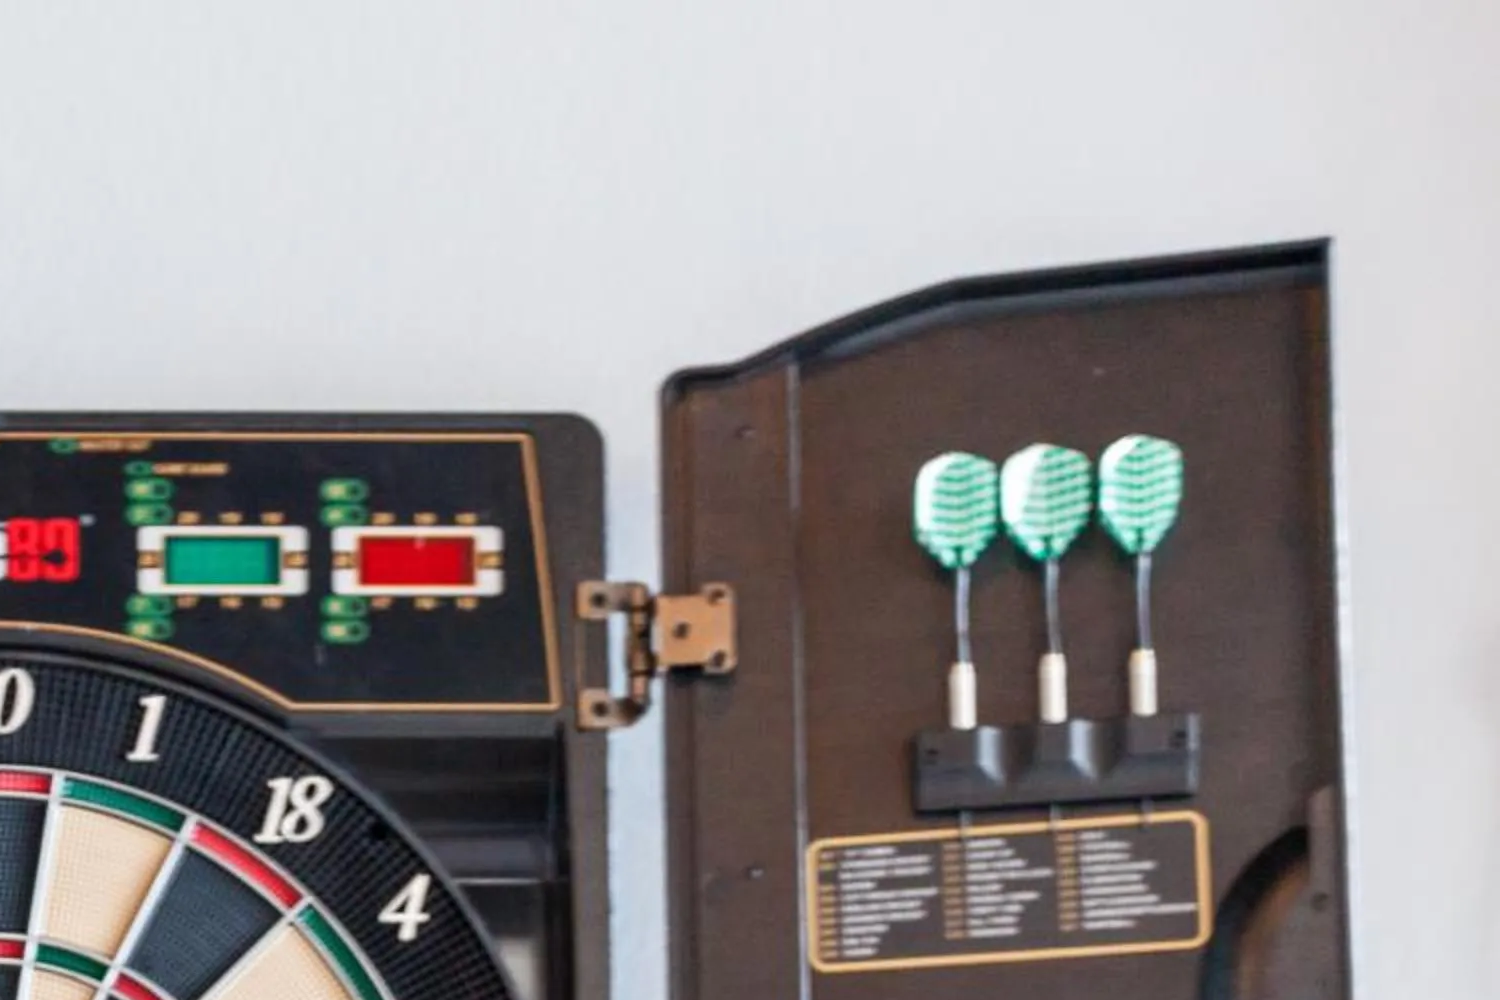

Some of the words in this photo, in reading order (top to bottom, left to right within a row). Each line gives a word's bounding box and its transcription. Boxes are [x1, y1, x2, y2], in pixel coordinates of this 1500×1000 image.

[126, 694, 167, 762] 1
[253, 774, 334, 844] 18
[377, 873, 431, 942] 4
